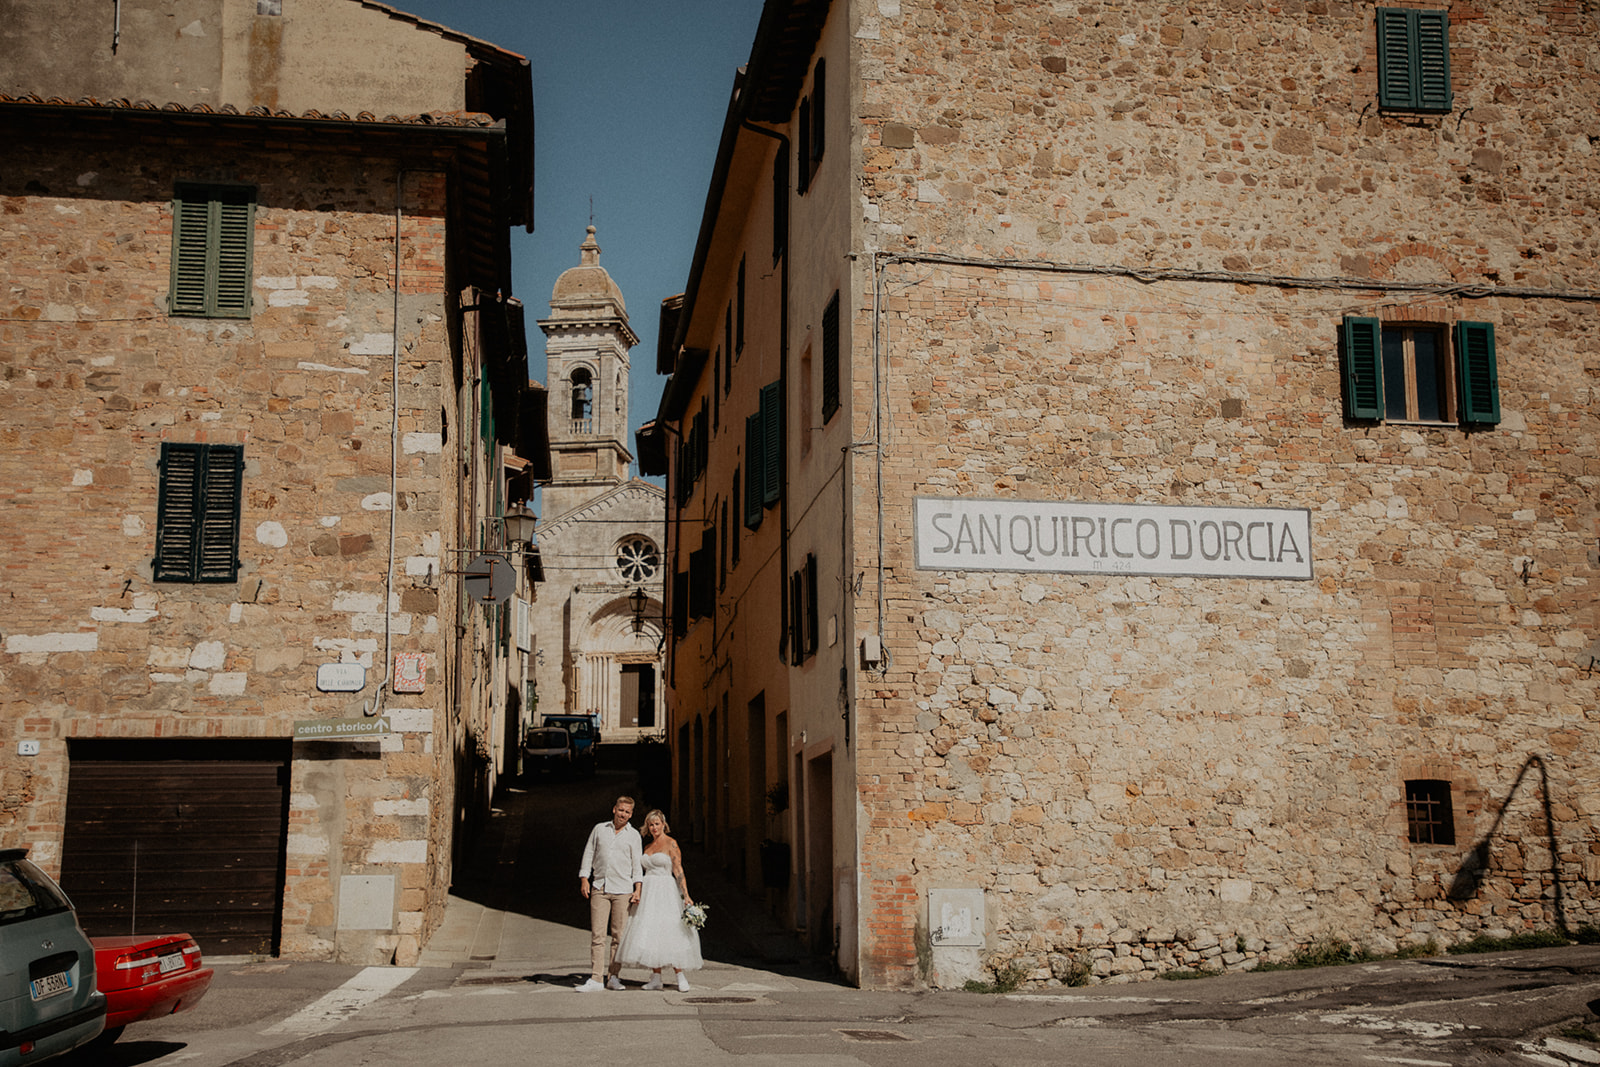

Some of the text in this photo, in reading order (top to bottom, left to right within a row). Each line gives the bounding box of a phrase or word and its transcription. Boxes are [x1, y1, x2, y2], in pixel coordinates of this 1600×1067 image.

[932, 513, 1304, 563] SAN QUIRICO D'ORCIA
[1112, 561, 1131, 570] 424
[298, 721, 372, 734] centro storico
